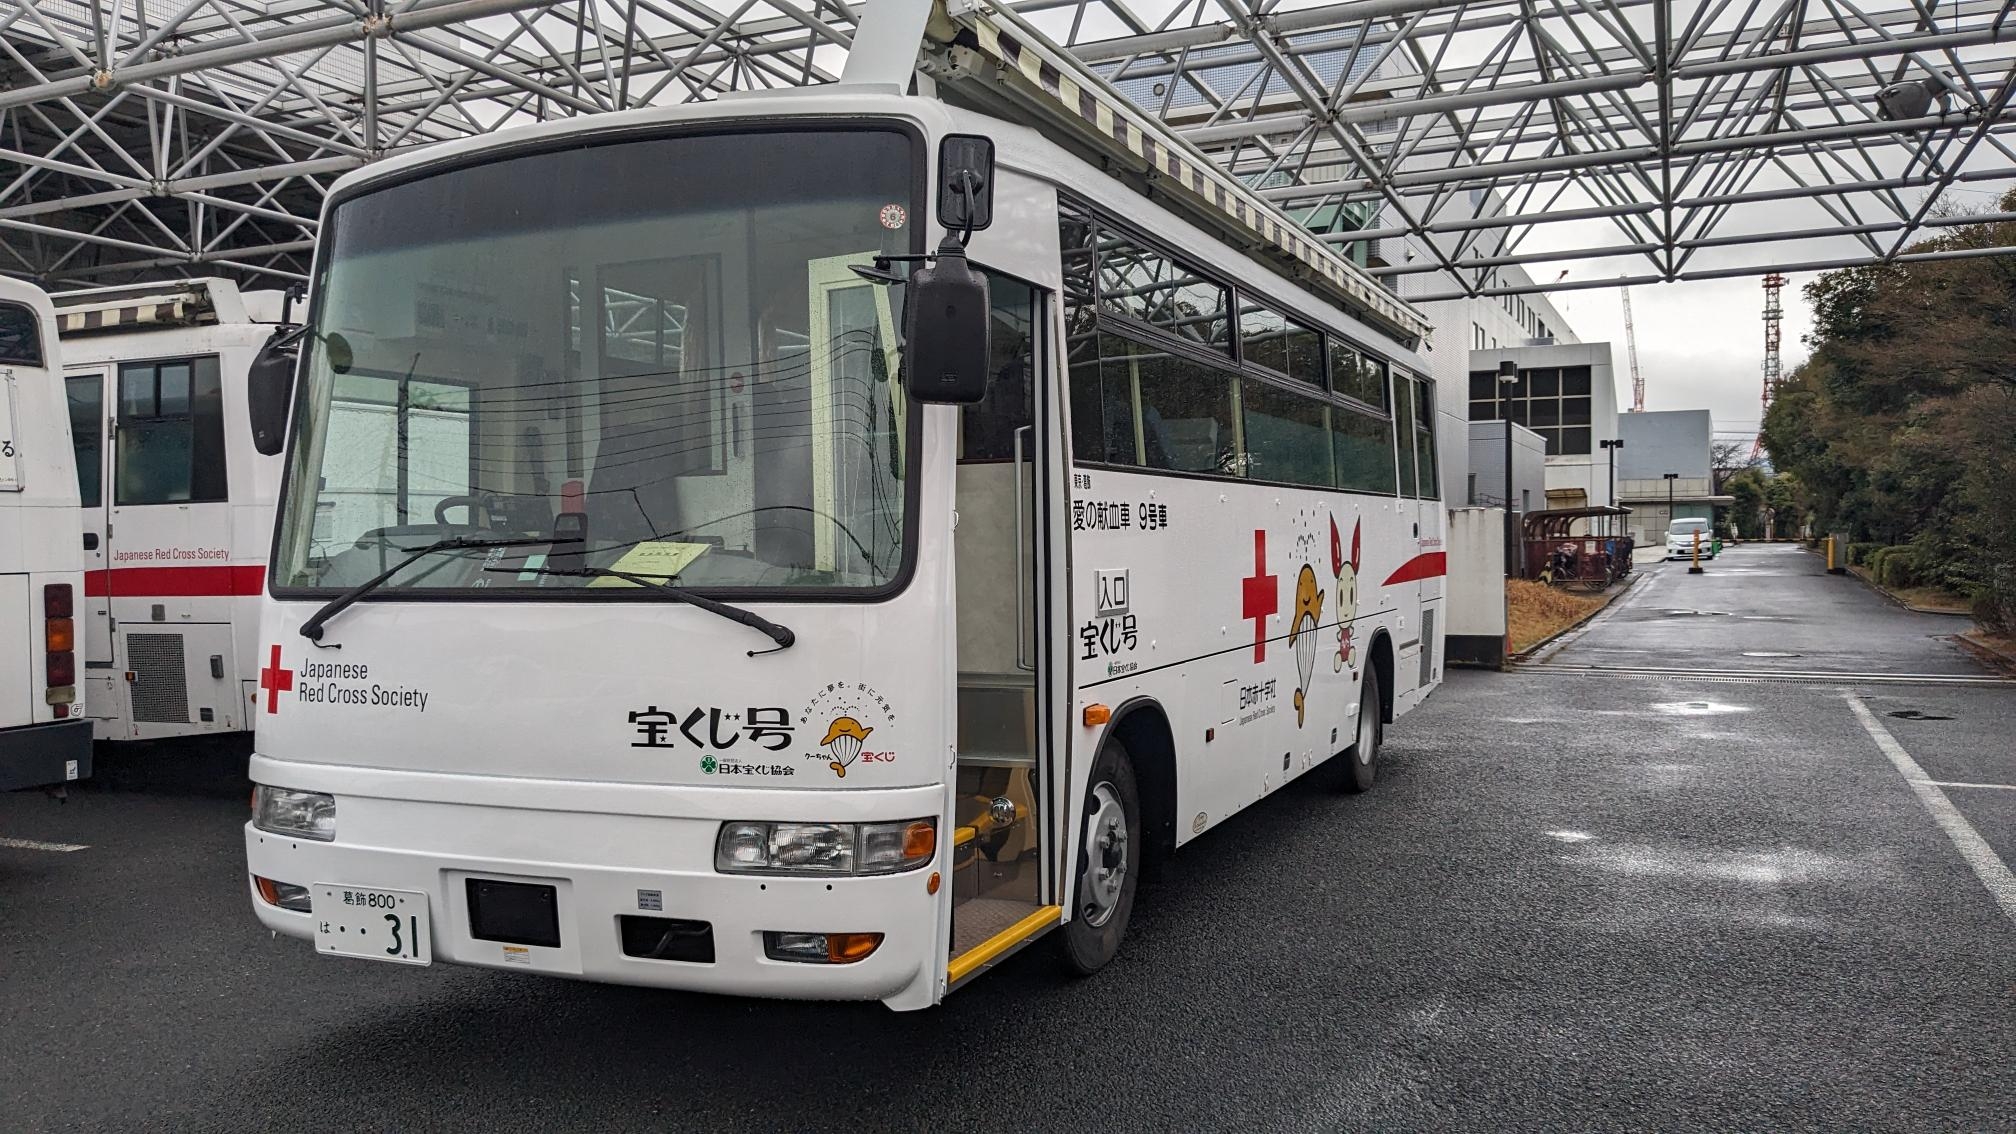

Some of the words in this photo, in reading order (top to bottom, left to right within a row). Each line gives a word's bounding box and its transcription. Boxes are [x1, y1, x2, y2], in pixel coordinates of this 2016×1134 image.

[1073, 500, 1131, 531] 愛の献血車
[1138, 502, 1168, 531] 9号車
[114, 549, 153, 562] Japanese
[155, 548, 171, 560] Red
[172, 547, 196, 560] Cross
[198, 547, 230, 561] Society
[1100, 577, 1125, 609] 入口
[1080, 614, 1138, 661] 宝くじ号
[300, 658, 368, 682] Japanese
[299, 682, 324, 702] Red
[328, 683, 367, 704] Cross
[371, 684, 429, 712] Society
[628, 706, 795, 751] 宝くじ号
[719, 763, 795, 776] 日本宝くじ協会
[861, 752, 895, 762] 宝くじ
[320, 920, 331, 934] は
